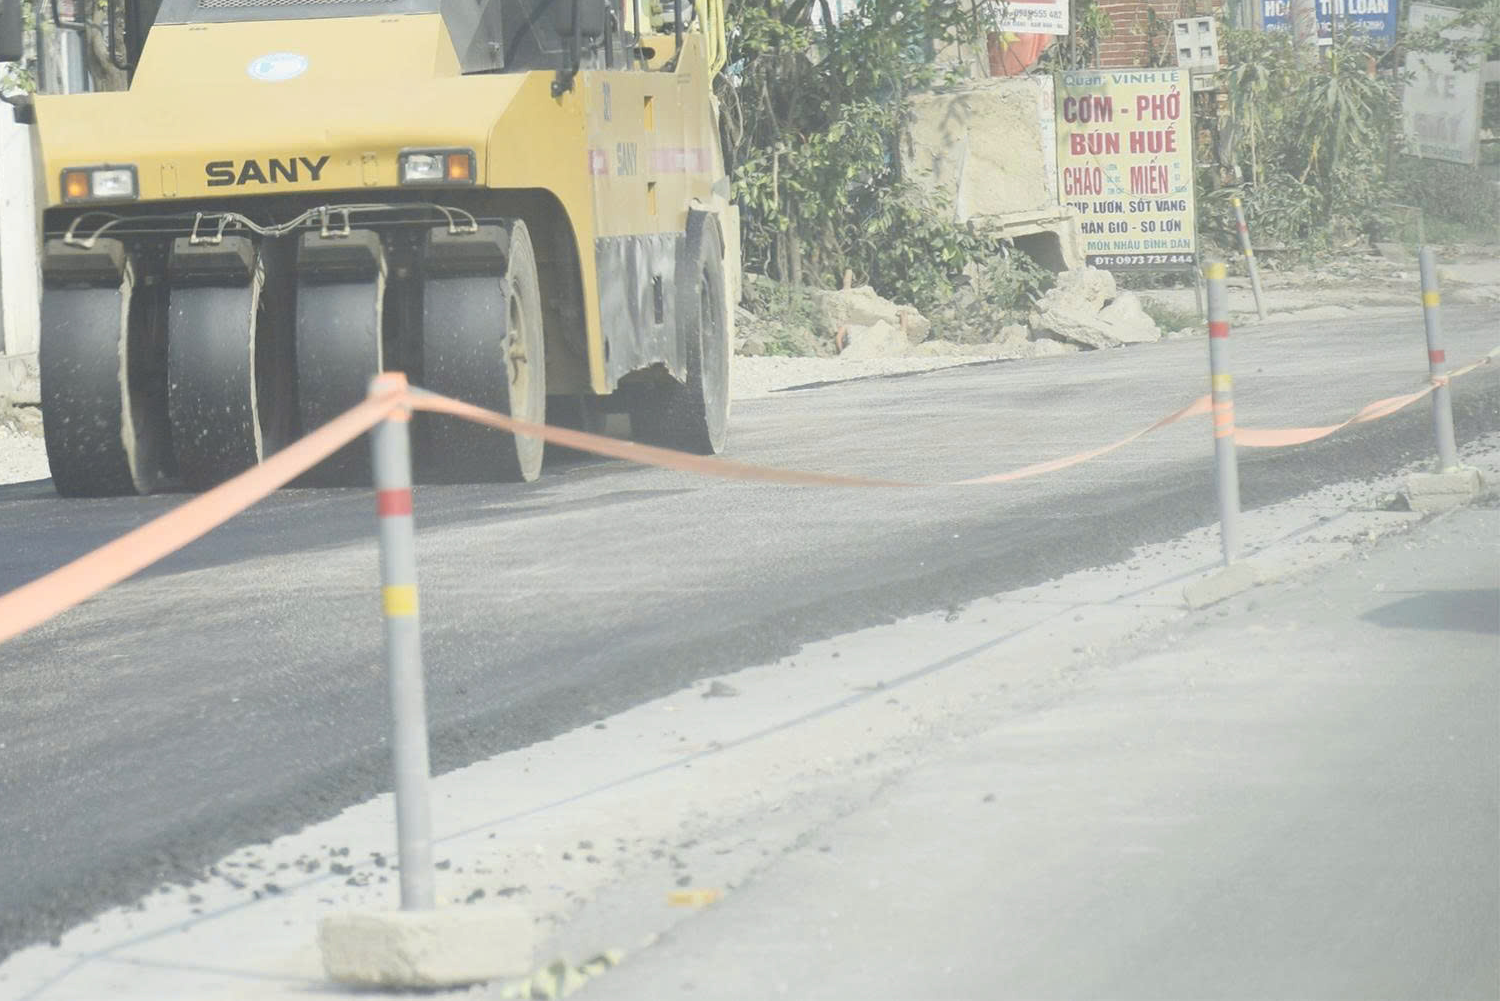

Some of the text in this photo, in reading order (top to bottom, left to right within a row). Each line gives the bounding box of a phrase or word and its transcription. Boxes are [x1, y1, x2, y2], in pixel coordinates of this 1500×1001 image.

[1112, 73, 1155, 85] VINH
[1063, 93, 1112, 123] CƠM
[1136, 84, 1180, 121] PHỞ
[1071, 122, 1177, 156] BÚN HUẾ
[205, 156, 331, 187] SANY
[1064, 161, 1102, 196] CHÁO
[1130, 156, 1168, 195] MIẾN
[1155, 199, 1186, 212] VANG
[1116, 255, 1145, 264] 0973
[1147, 255, 1168, 264] 737
[1171, 254, 1193, 263] 444
